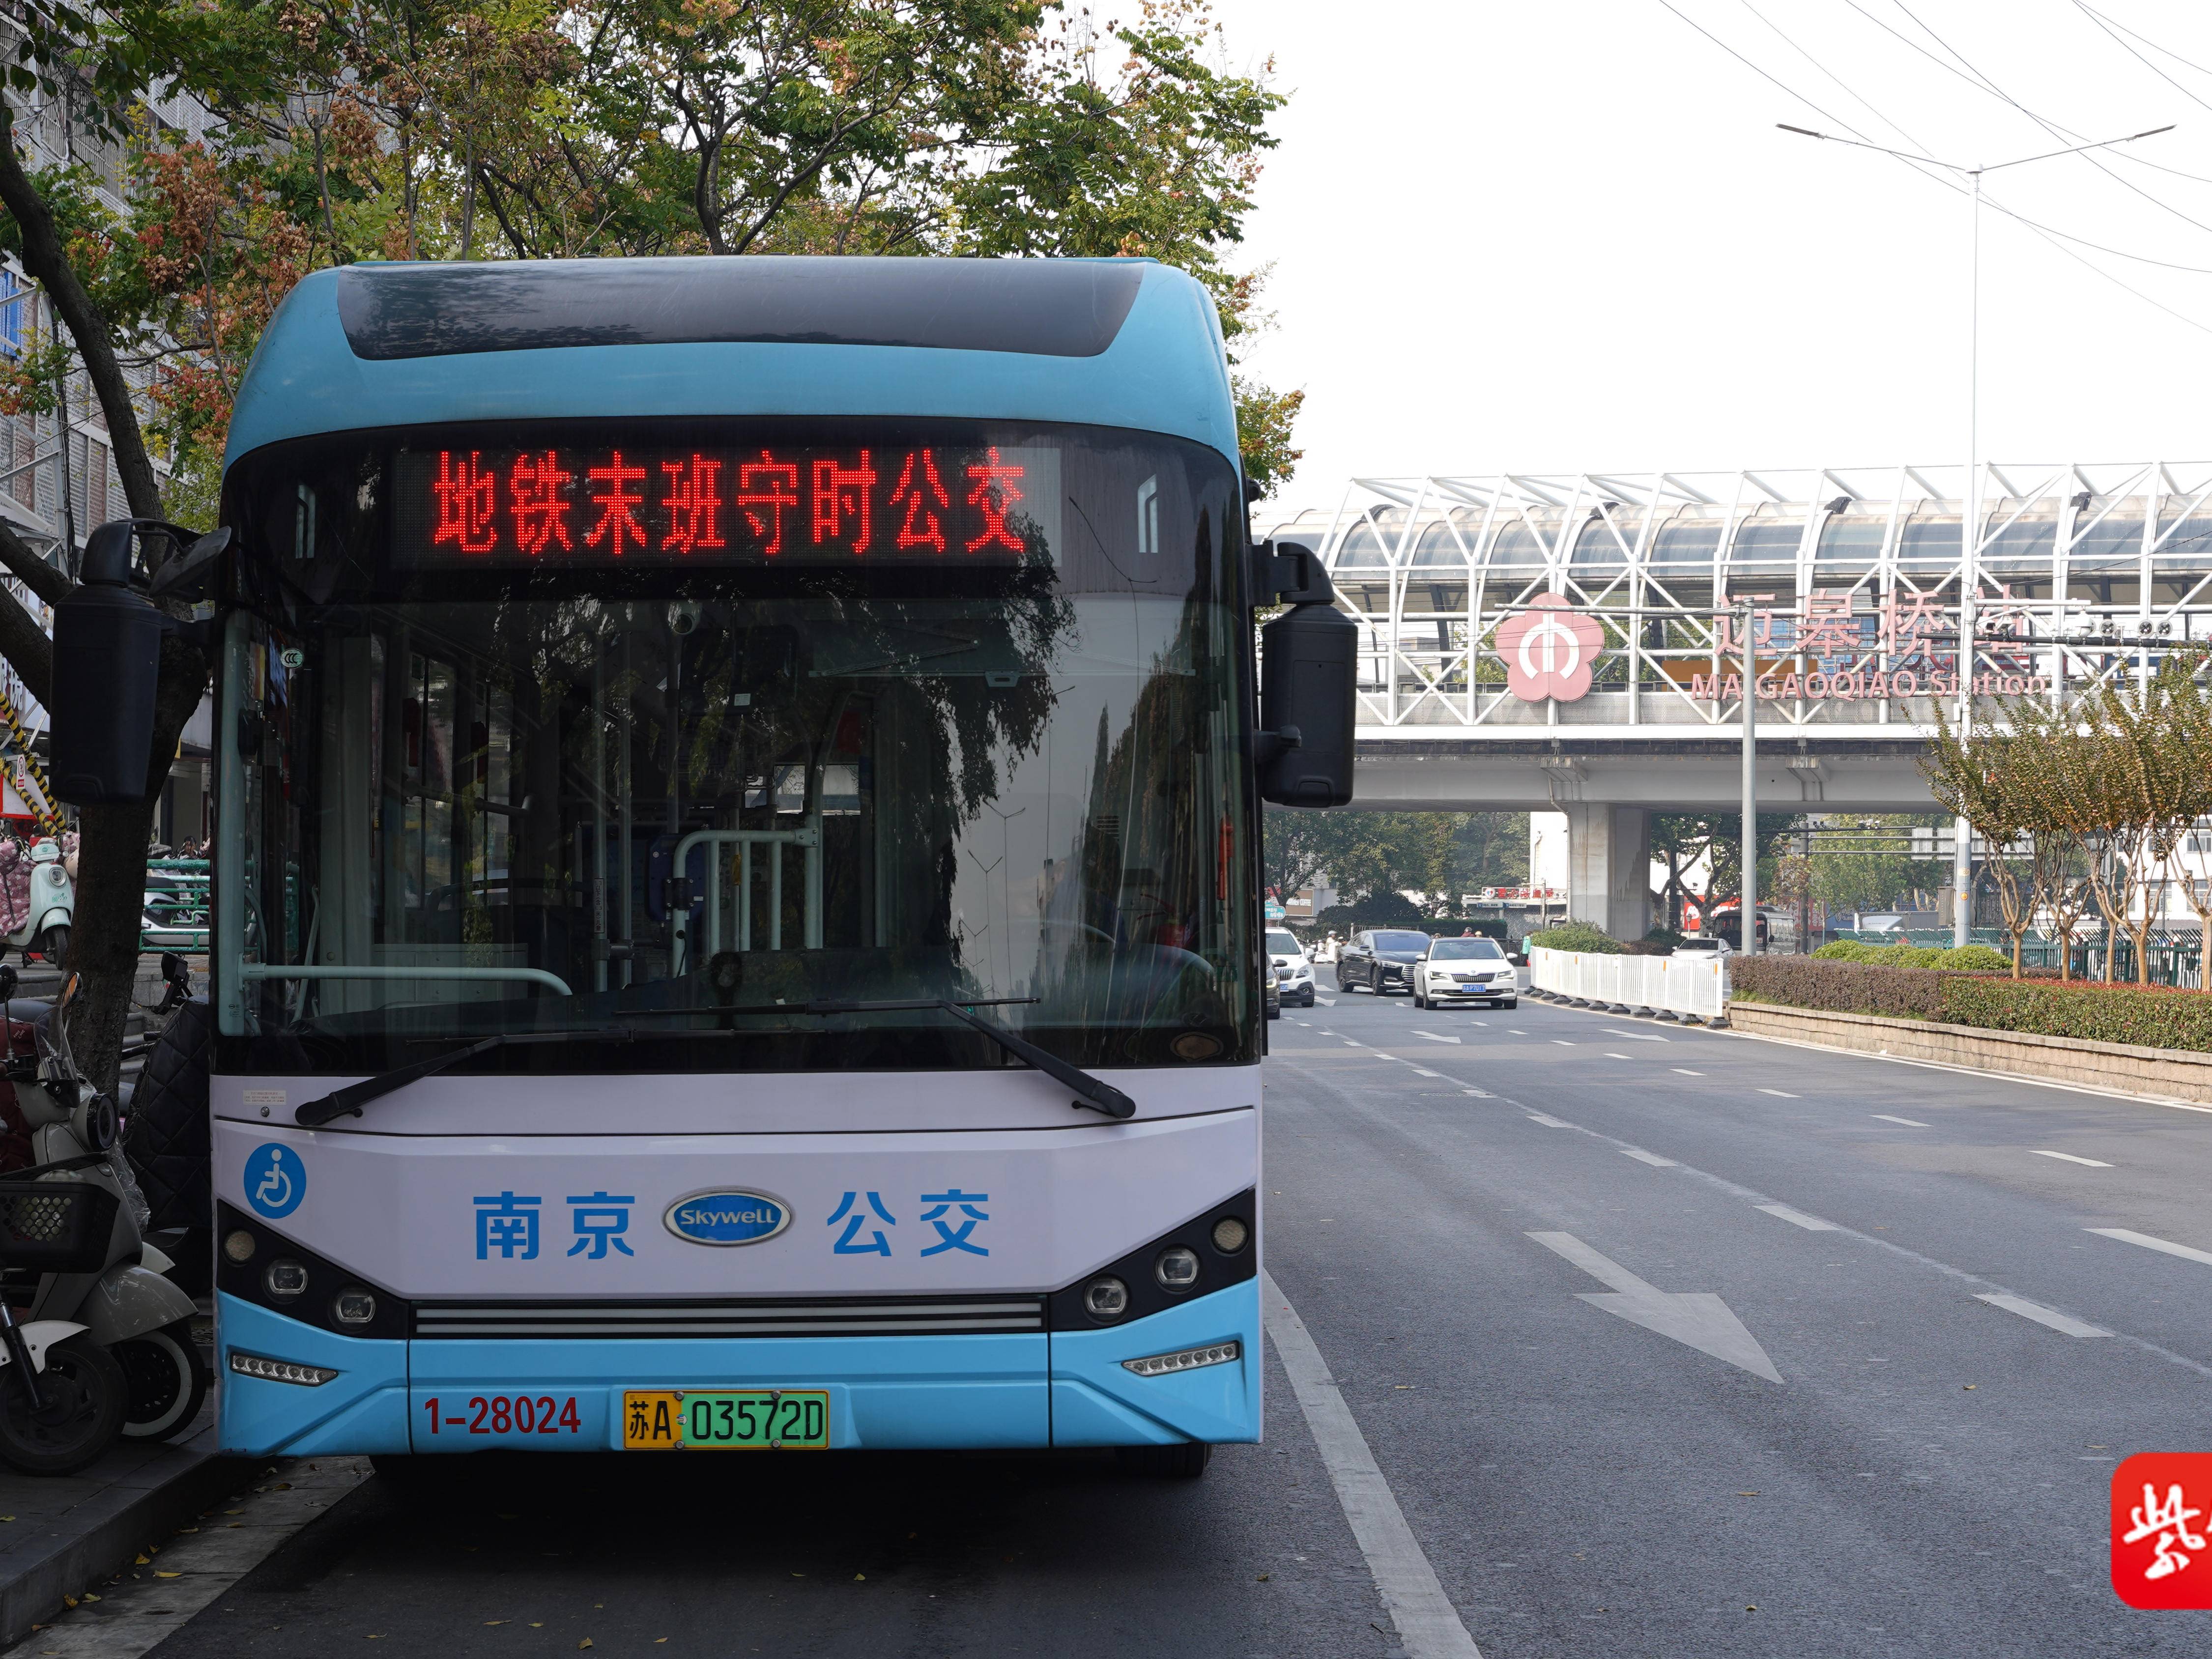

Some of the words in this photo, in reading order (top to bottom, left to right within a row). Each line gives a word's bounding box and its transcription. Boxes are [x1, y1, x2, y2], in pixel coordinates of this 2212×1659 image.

[434, 449, 1024, 553] 地铁末班守时公交
[1692, 671, 1917, 702] MAGAOQIAO
[473, 1191, 635, 1260] 南京
[827, 1189, 989, 1257] 公交
[680, 1208, 776, 1226] Skywell
[425, 1396, 581, 1434] 1-28024
